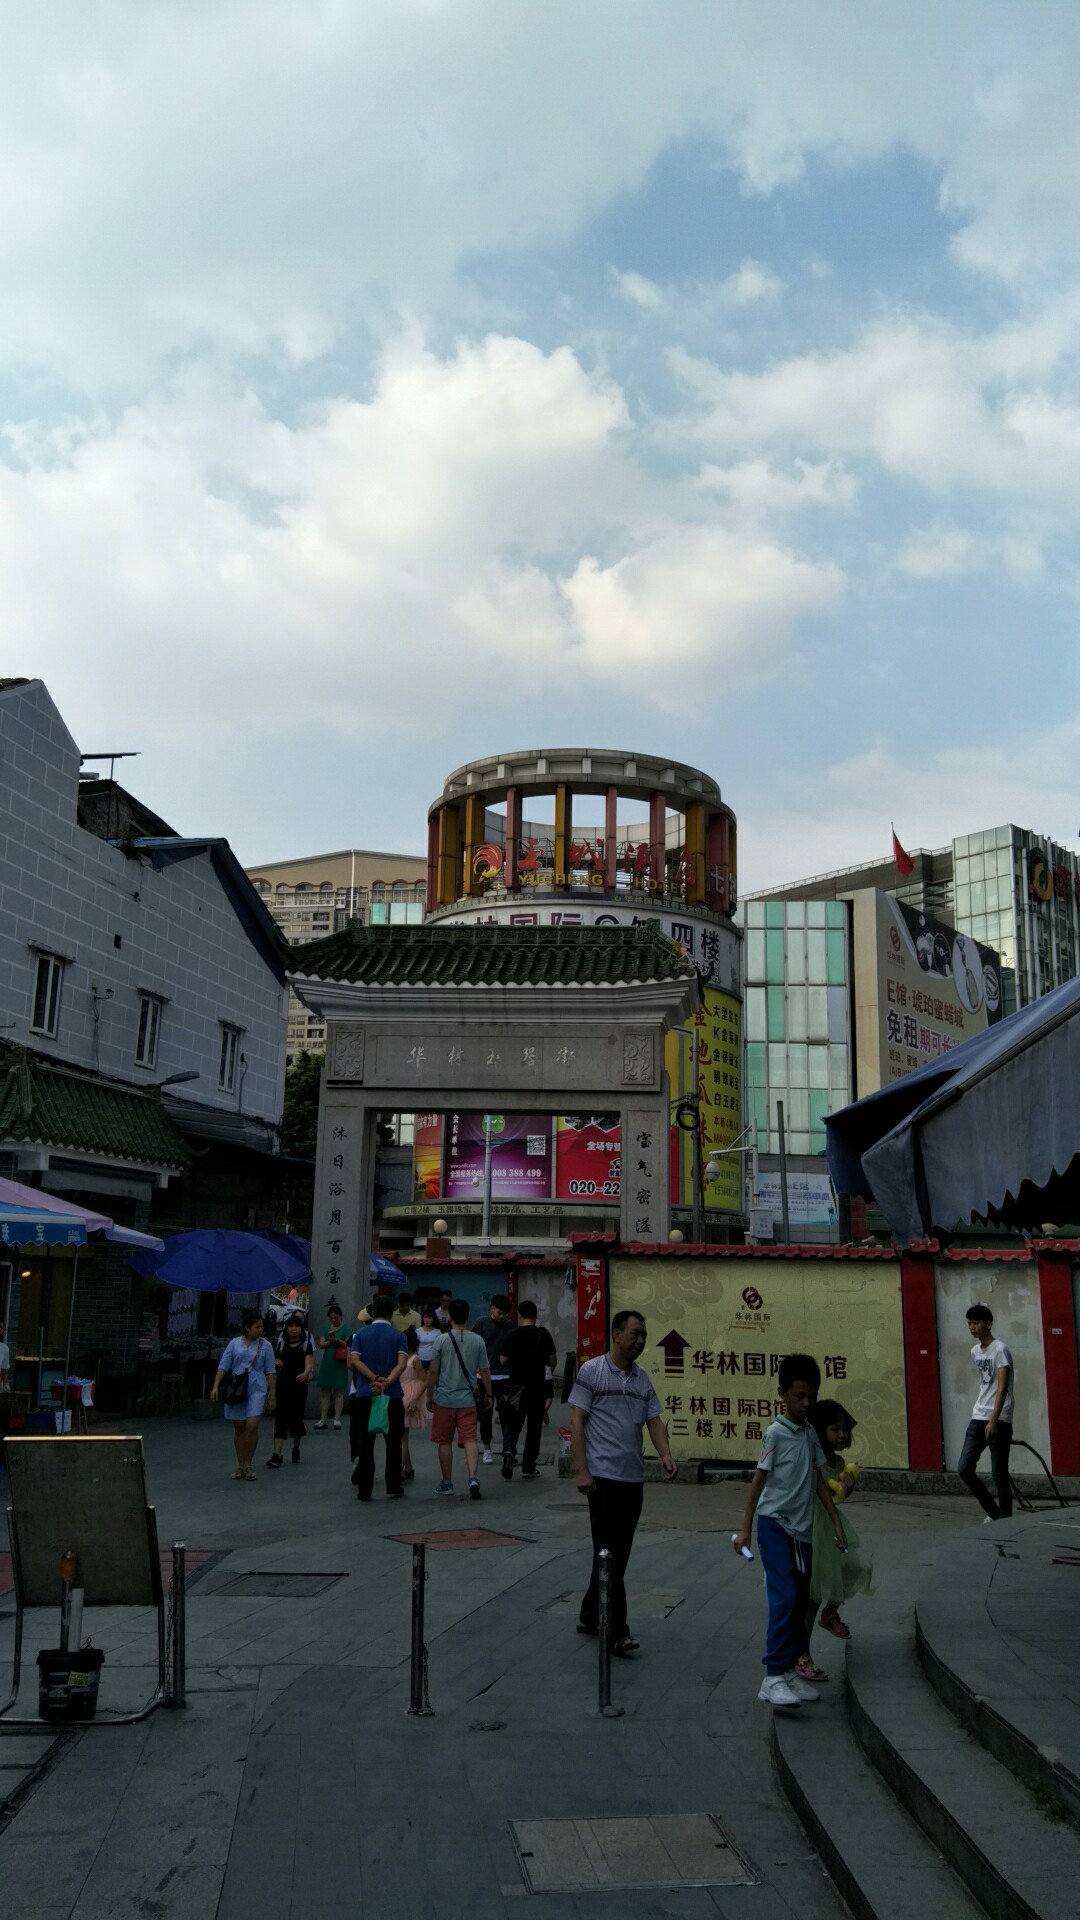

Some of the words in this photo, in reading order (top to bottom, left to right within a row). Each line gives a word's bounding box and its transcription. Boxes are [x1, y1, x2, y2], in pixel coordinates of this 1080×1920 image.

[518, 873, 605, 888] YUCHENG
[407, 1046, 576, 1070] 华林玉器街
[509, 1169, 524, 1178] 388
[526, 1169, 542, 1178] 499
[735, 1312, 771, 1322] 华林国际
[693, 1351, 848, 1380] 华林国际馆
